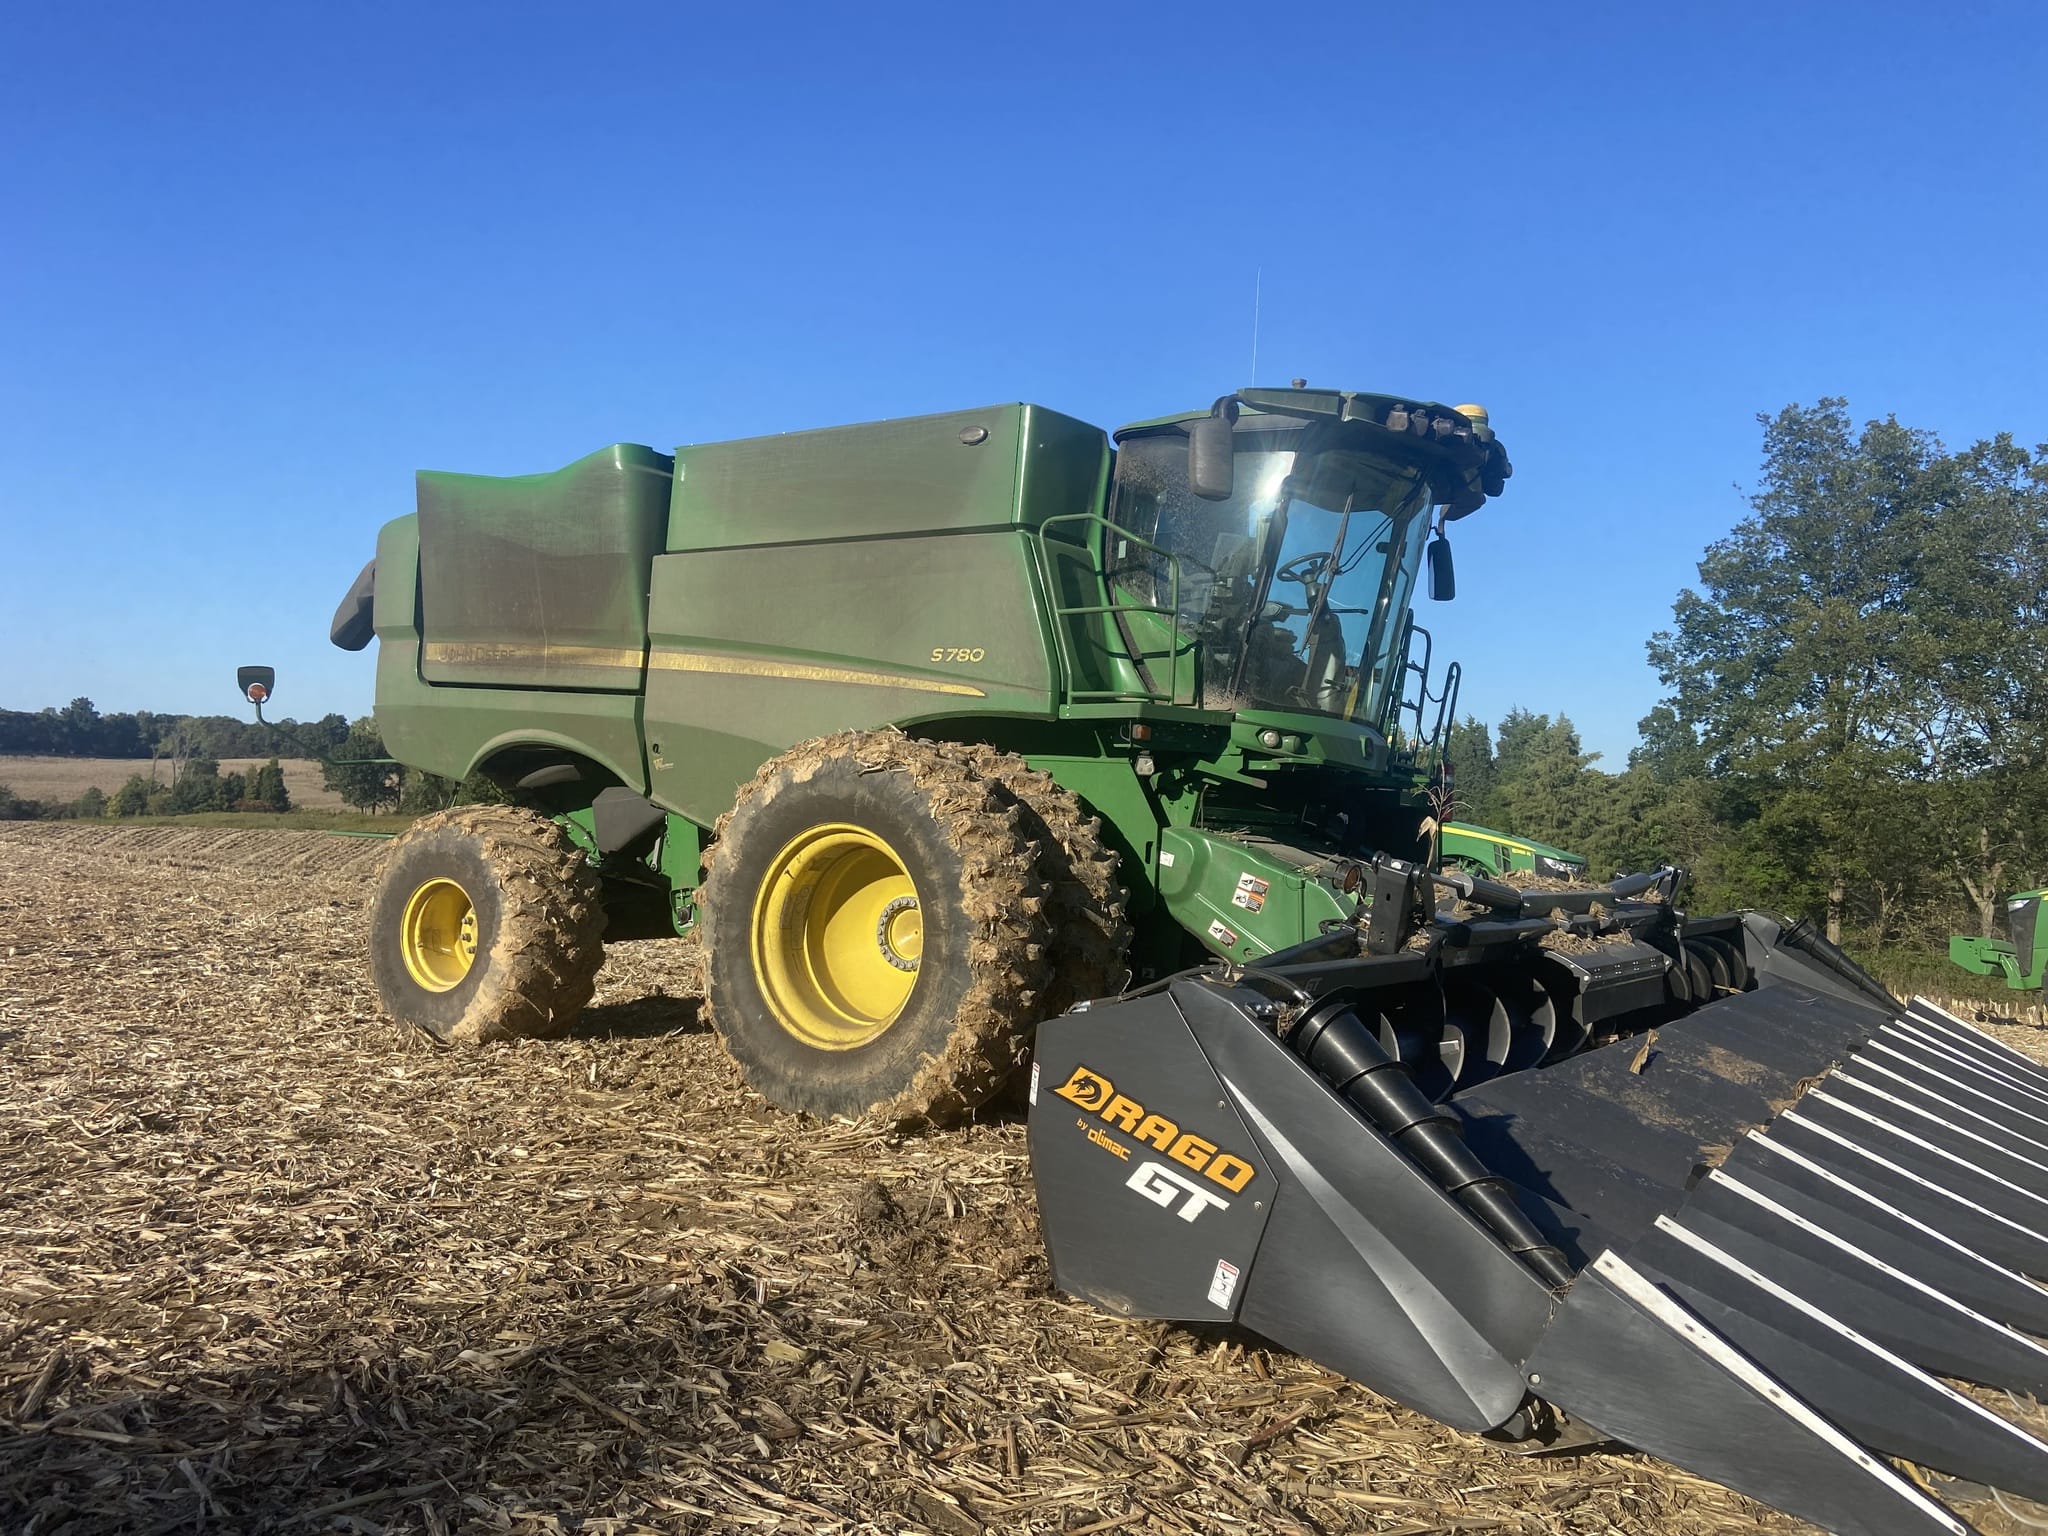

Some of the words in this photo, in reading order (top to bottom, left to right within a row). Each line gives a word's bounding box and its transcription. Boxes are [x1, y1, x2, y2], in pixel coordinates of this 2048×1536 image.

[1053, 1066, 1255, 1193] DRAGO
[1076, 1117, 1088, 1131] by
[1125, 1161, 1230, 1223] GT
